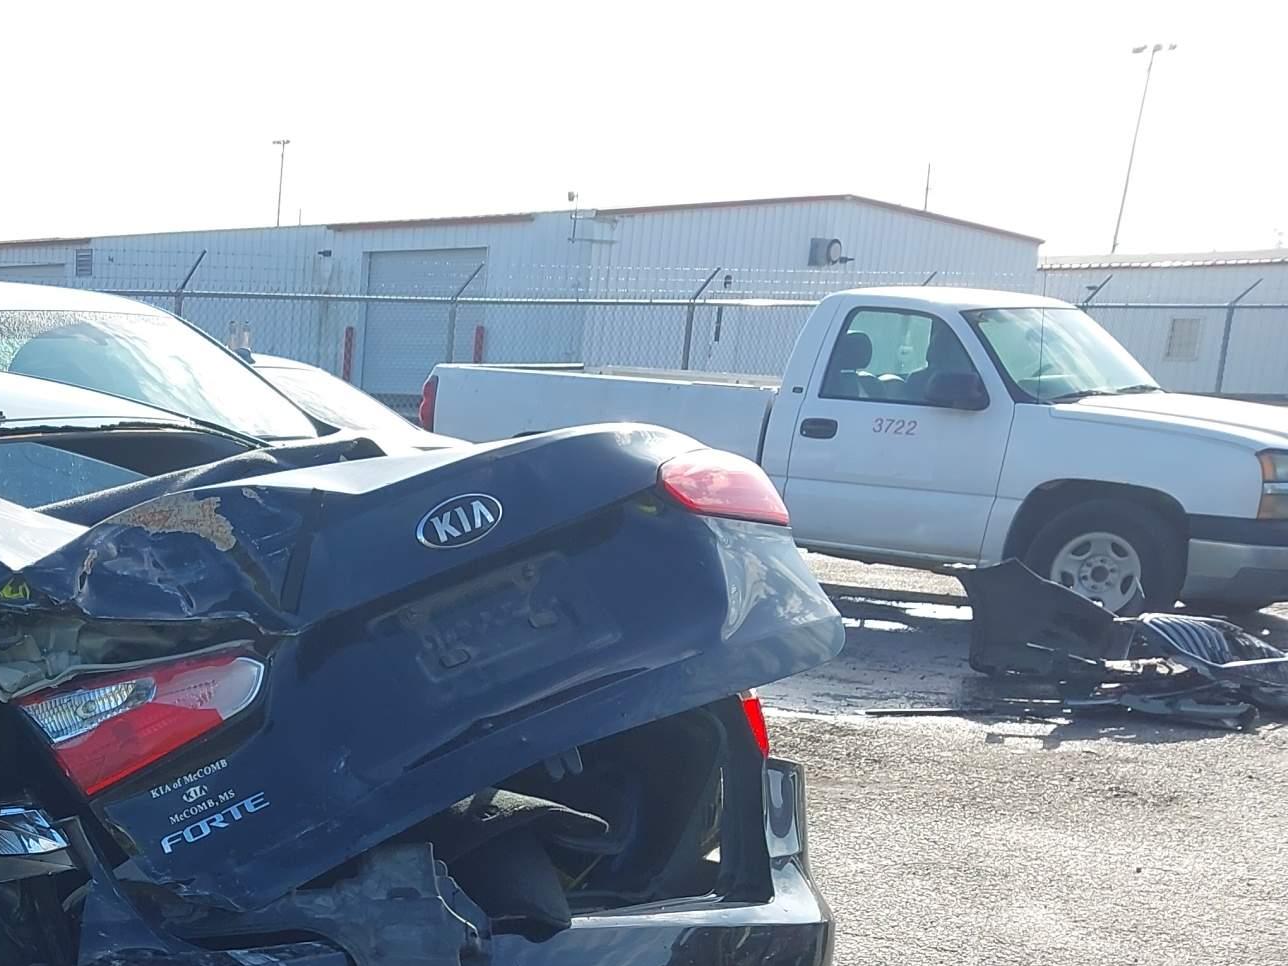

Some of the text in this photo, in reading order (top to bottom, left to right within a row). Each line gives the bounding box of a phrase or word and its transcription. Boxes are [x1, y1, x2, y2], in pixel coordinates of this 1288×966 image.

[872, 418, 918, 435] 3722
[430, 499, 495, 543] KIA
[150, 759, 228, 799] KIA of McCOMB
[160, 791, 271, 854] FORTE
[169, 788, 236, 825] McCOMB, MS
